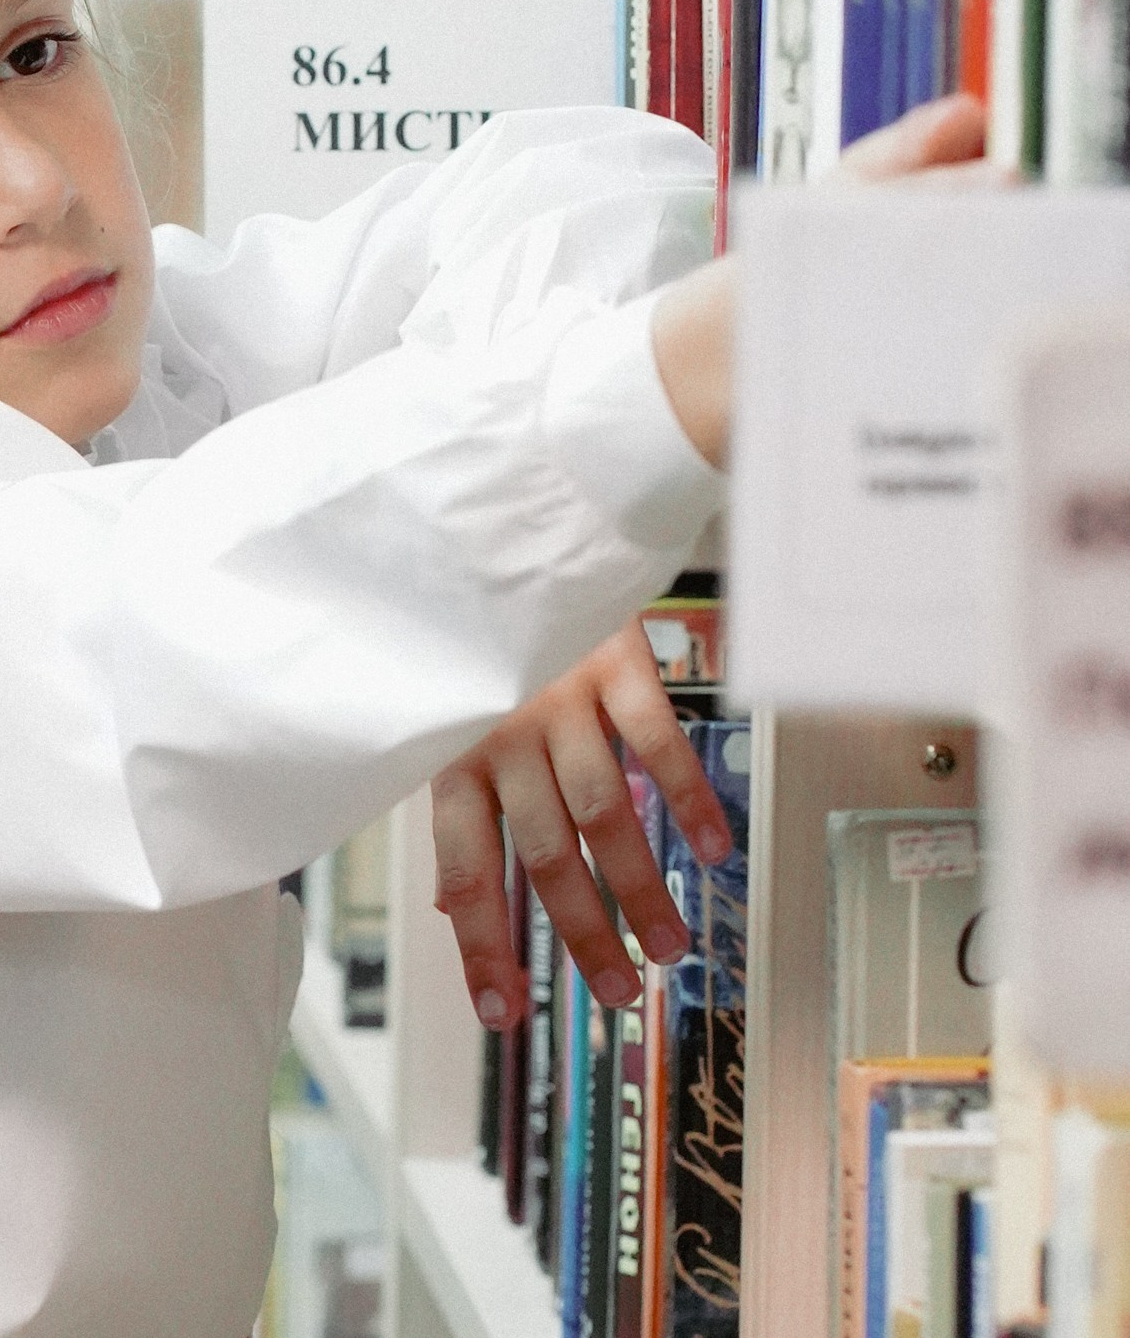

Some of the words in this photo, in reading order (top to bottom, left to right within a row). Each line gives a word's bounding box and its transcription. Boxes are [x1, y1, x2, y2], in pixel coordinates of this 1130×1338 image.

[291, 43, 392, 88] 86.4
[292, 108, 494, 153] МИСТ
[617, 1082, 644, 1277] ГЕНОН
